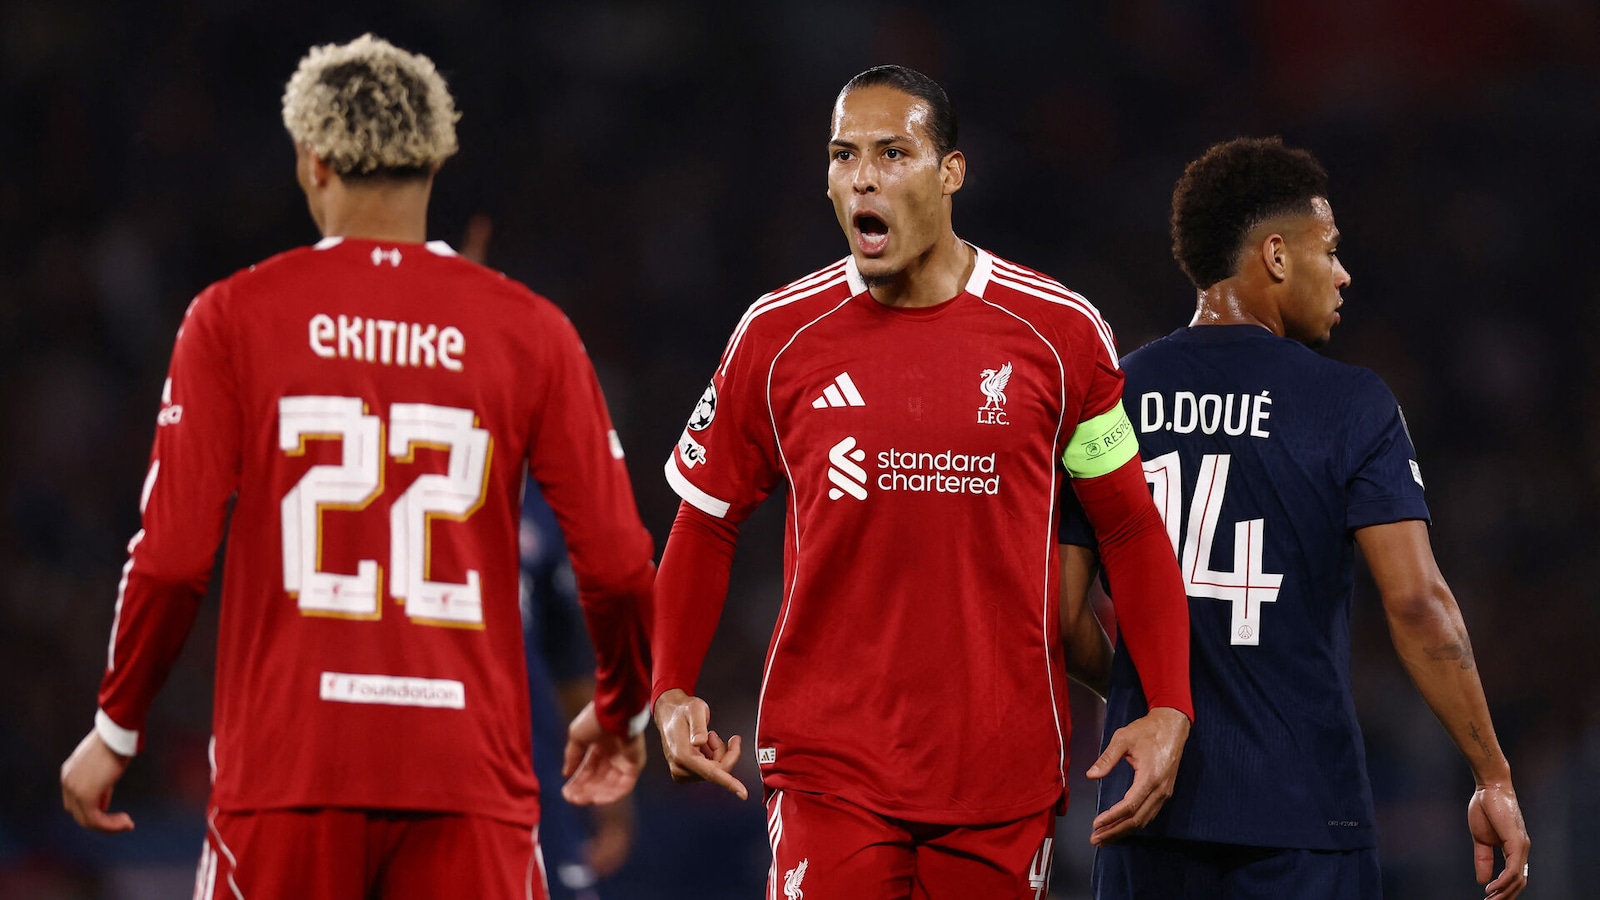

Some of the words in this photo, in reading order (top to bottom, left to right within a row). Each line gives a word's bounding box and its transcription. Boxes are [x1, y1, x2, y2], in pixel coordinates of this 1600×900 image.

[977, 411, 1010, 425] L.F.C.
[1141, 390, 1272, 438] D.DOUÉ
[877, 448, 996, 473] standard
[877, 470, 1000, 495] chartered
[278, 395, 494, 630] 22
[1141, 450, 1284, 646] 14
